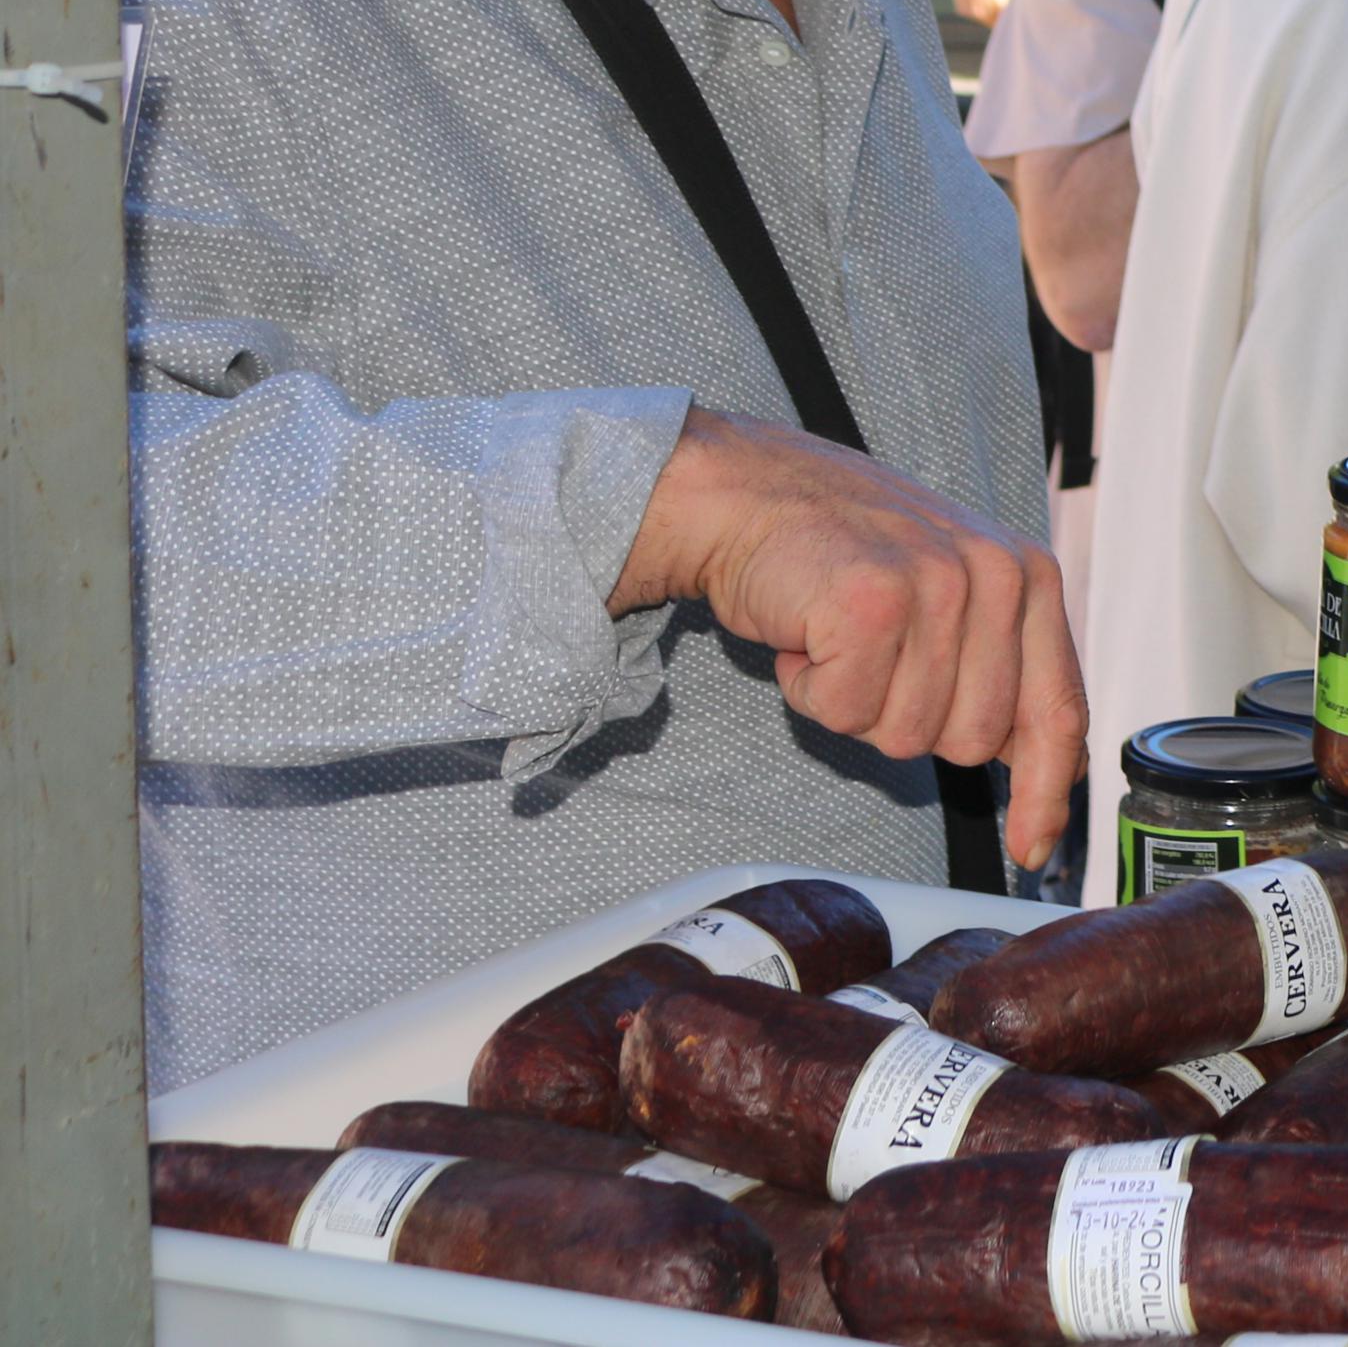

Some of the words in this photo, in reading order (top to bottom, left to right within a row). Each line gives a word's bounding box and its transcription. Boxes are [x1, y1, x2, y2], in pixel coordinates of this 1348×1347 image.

[1262, 878, 1307, 1019] CERVERA
[1265, 913, 1283, 989] EMBUTIDOS
[1110, 1177, 1156, 1195] 18923
